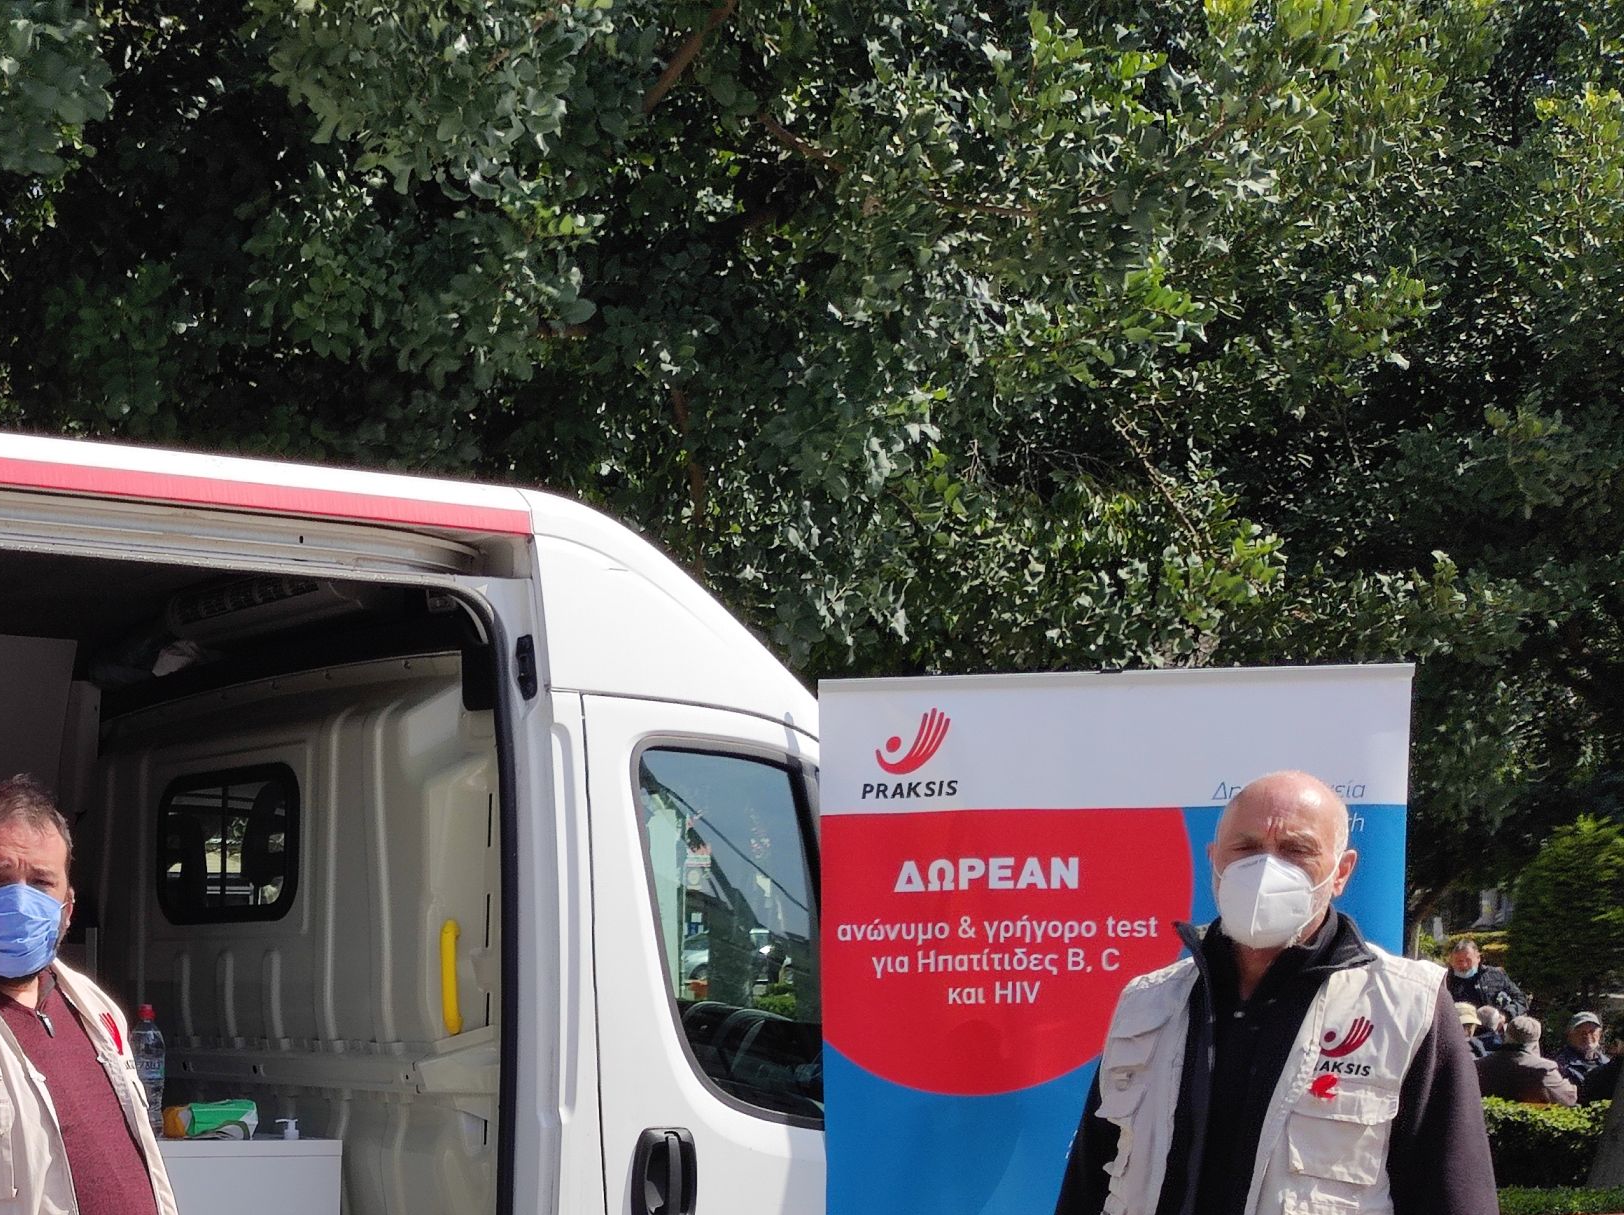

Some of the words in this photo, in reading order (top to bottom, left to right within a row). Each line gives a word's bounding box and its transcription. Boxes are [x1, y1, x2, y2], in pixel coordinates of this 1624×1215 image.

[862, 779, 959, 800] PRAKSIS
[1330, 779, 1366, 799] εία
[894, 857, 1079, 892] ΔΩΡΕΑΝ
[837, 917, 951, 945] ανώνυμο
[959, 916, 976, 938] &
[983, 917, 1097, 943] γρήγορο
[1105, 914, 1159, 938] test
[872, 953, 910, 978] για
[917, 949, 1058, 974] Ηπατίτιδες
[1068, 949, 1094, 973] B,
[1102, 948, 1121, 971] C
[947, 986, 986, 1004] και
[994, 980, 1040, 1004] HIV
[1315, 1060, 1371, 1077] AKSIS
